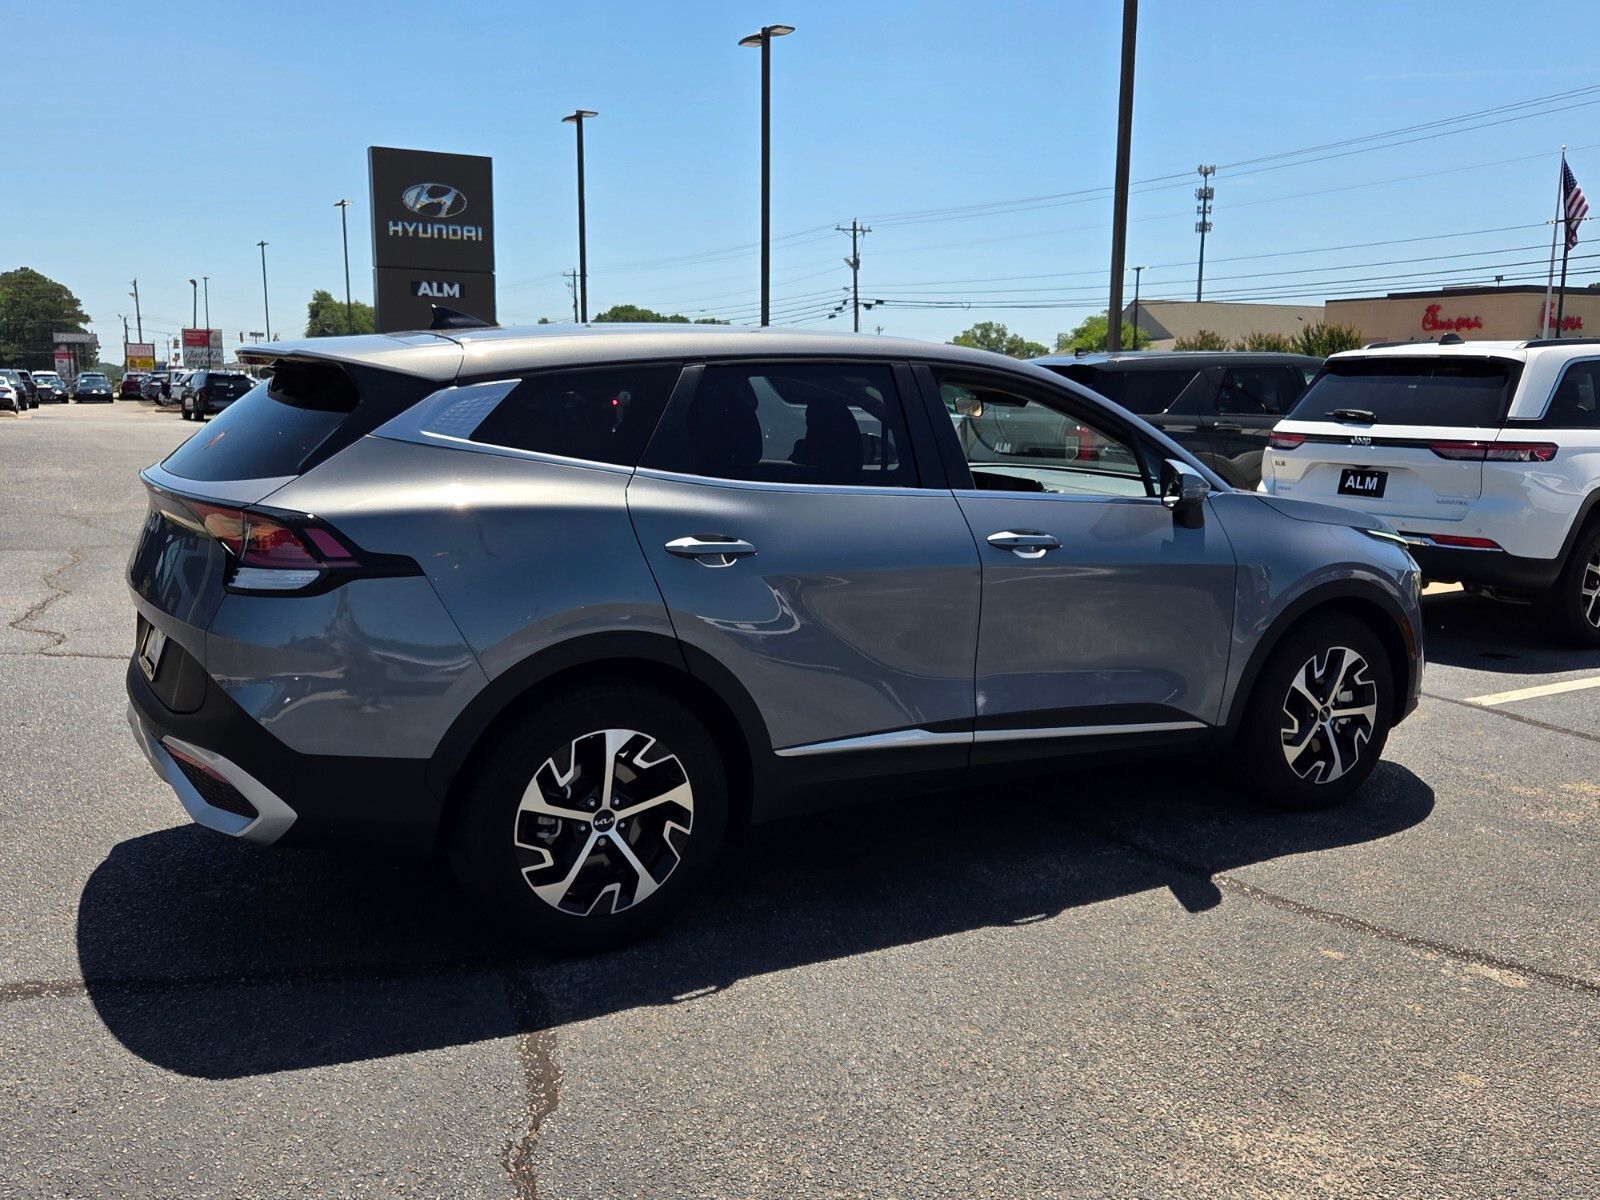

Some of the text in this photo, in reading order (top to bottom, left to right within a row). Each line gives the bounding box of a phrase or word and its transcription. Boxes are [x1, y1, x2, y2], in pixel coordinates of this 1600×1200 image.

[388, 221, 483, 242] HYUNDAI
[417, 281, 460, 299] ALM
[994, 442, 1011, 453] ALM
[1350, 435, 1372, 446] Jeep
[1345, 474, 1378, 491] ALM
